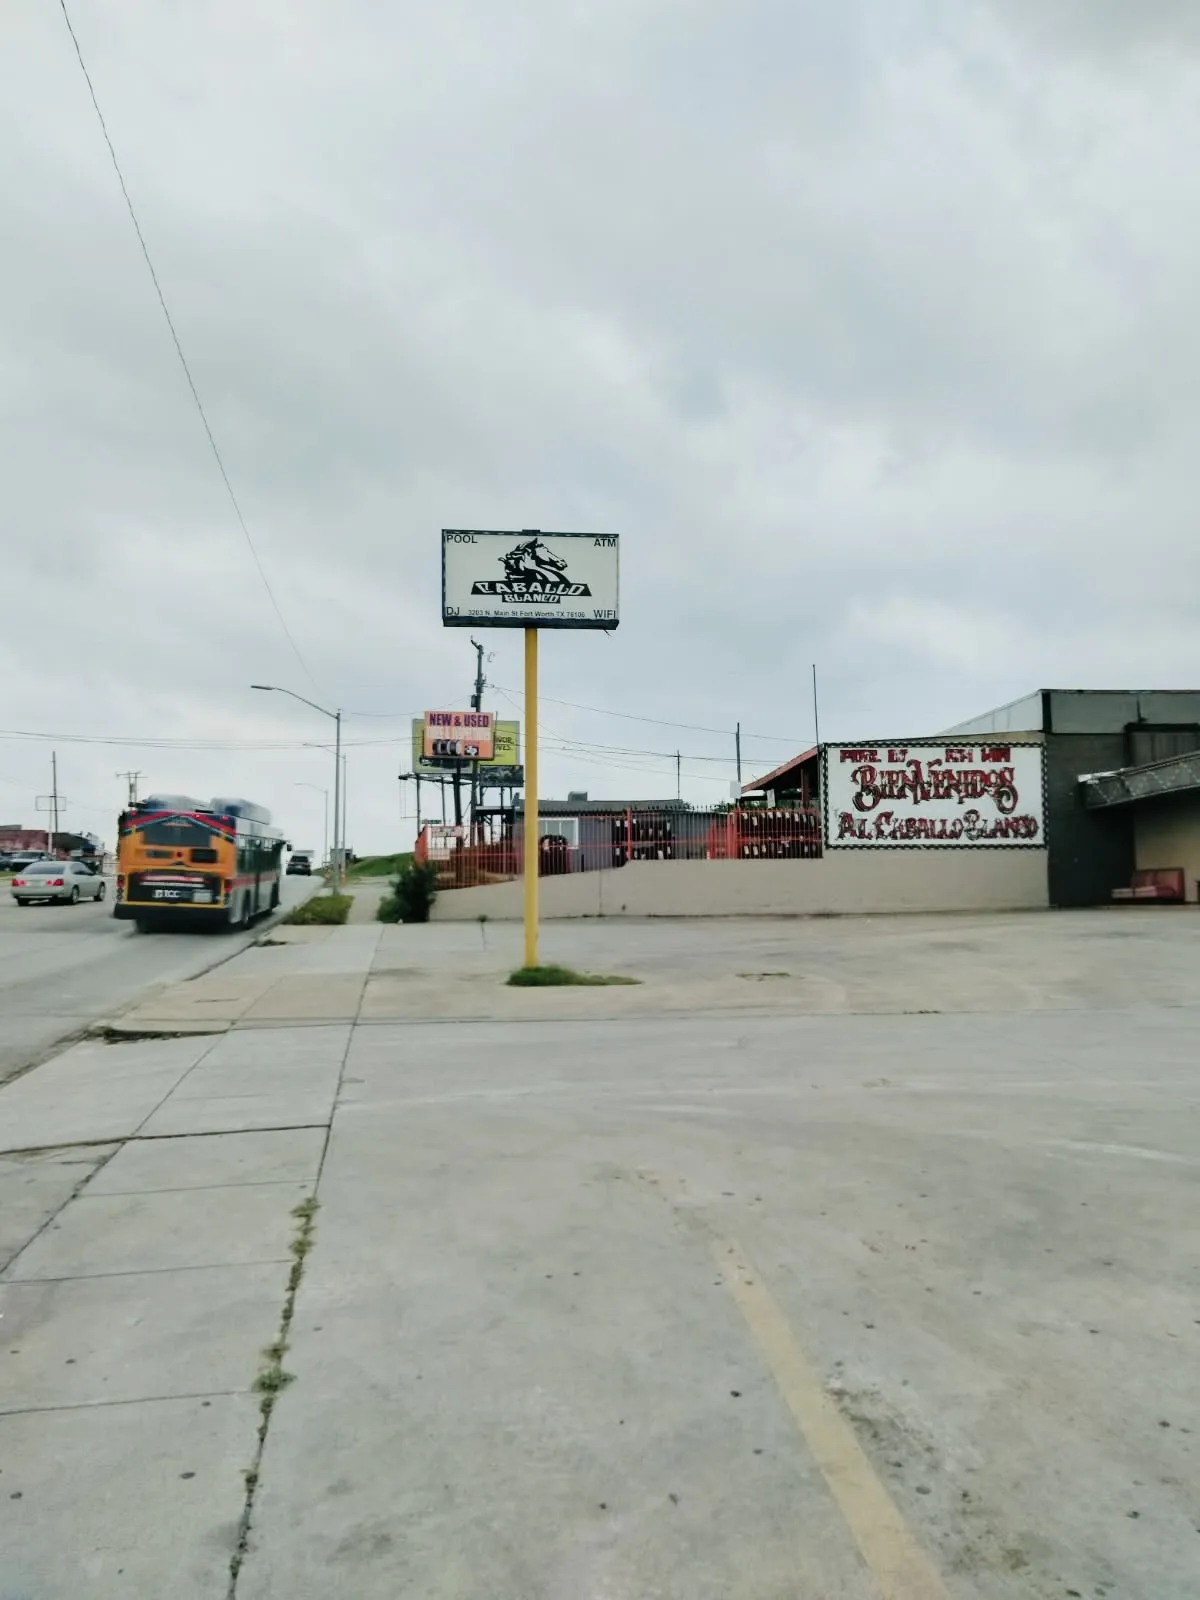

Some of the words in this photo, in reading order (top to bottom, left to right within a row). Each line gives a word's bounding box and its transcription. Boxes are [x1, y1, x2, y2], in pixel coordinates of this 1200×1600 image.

[446, 535, 478, 544] POOL
[593, 538, 616, 547] ATM
[475, 582, 585, 594] CABALLO
[504, 594, 559, 603] BLANCO
[446, 607, 460, 616] DJ
[593, 609, 616, 618] WIFI
[429, 713, 452, 726] NEW
[454, 716, 462, 727] &
[464, 714, 489, 728] USED
